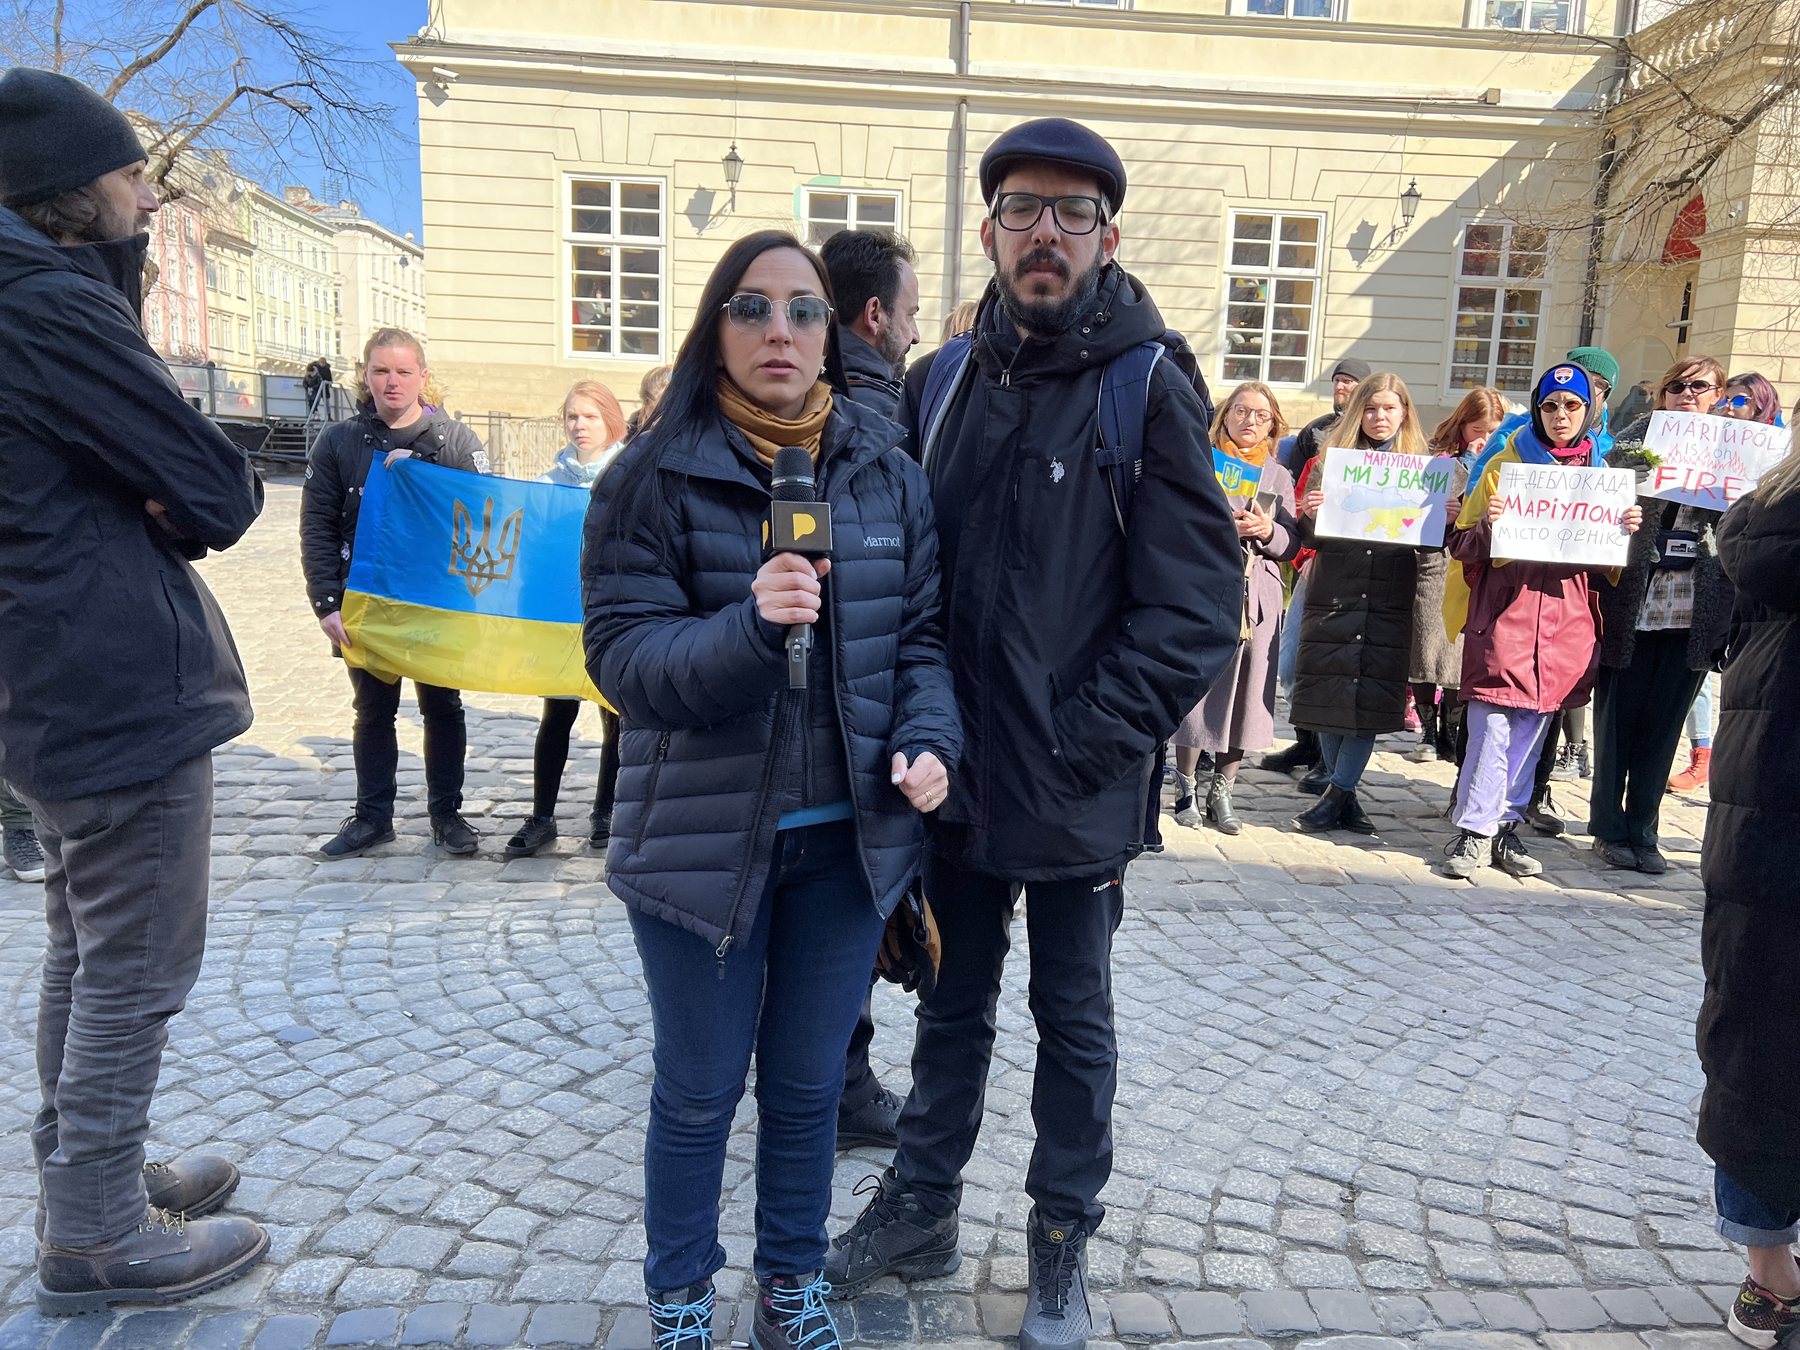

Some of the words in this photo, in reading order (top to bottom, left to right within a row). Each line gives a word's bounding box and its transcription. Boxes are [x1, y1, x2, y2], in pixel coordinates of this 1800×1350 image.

[1343, 465, 1372, 484] МИ
[1376, 467, 1390, 487] З
[1398, 469, 1450, 494] ВАМИ
[1505, 468, 1629, 495] #ДЕБЛОКАДА
[1654, 466, 1746, 501] FIRE
[863, 536, 901, 548] Marmot
[1498, 526, 1550, 541] МІСТО
